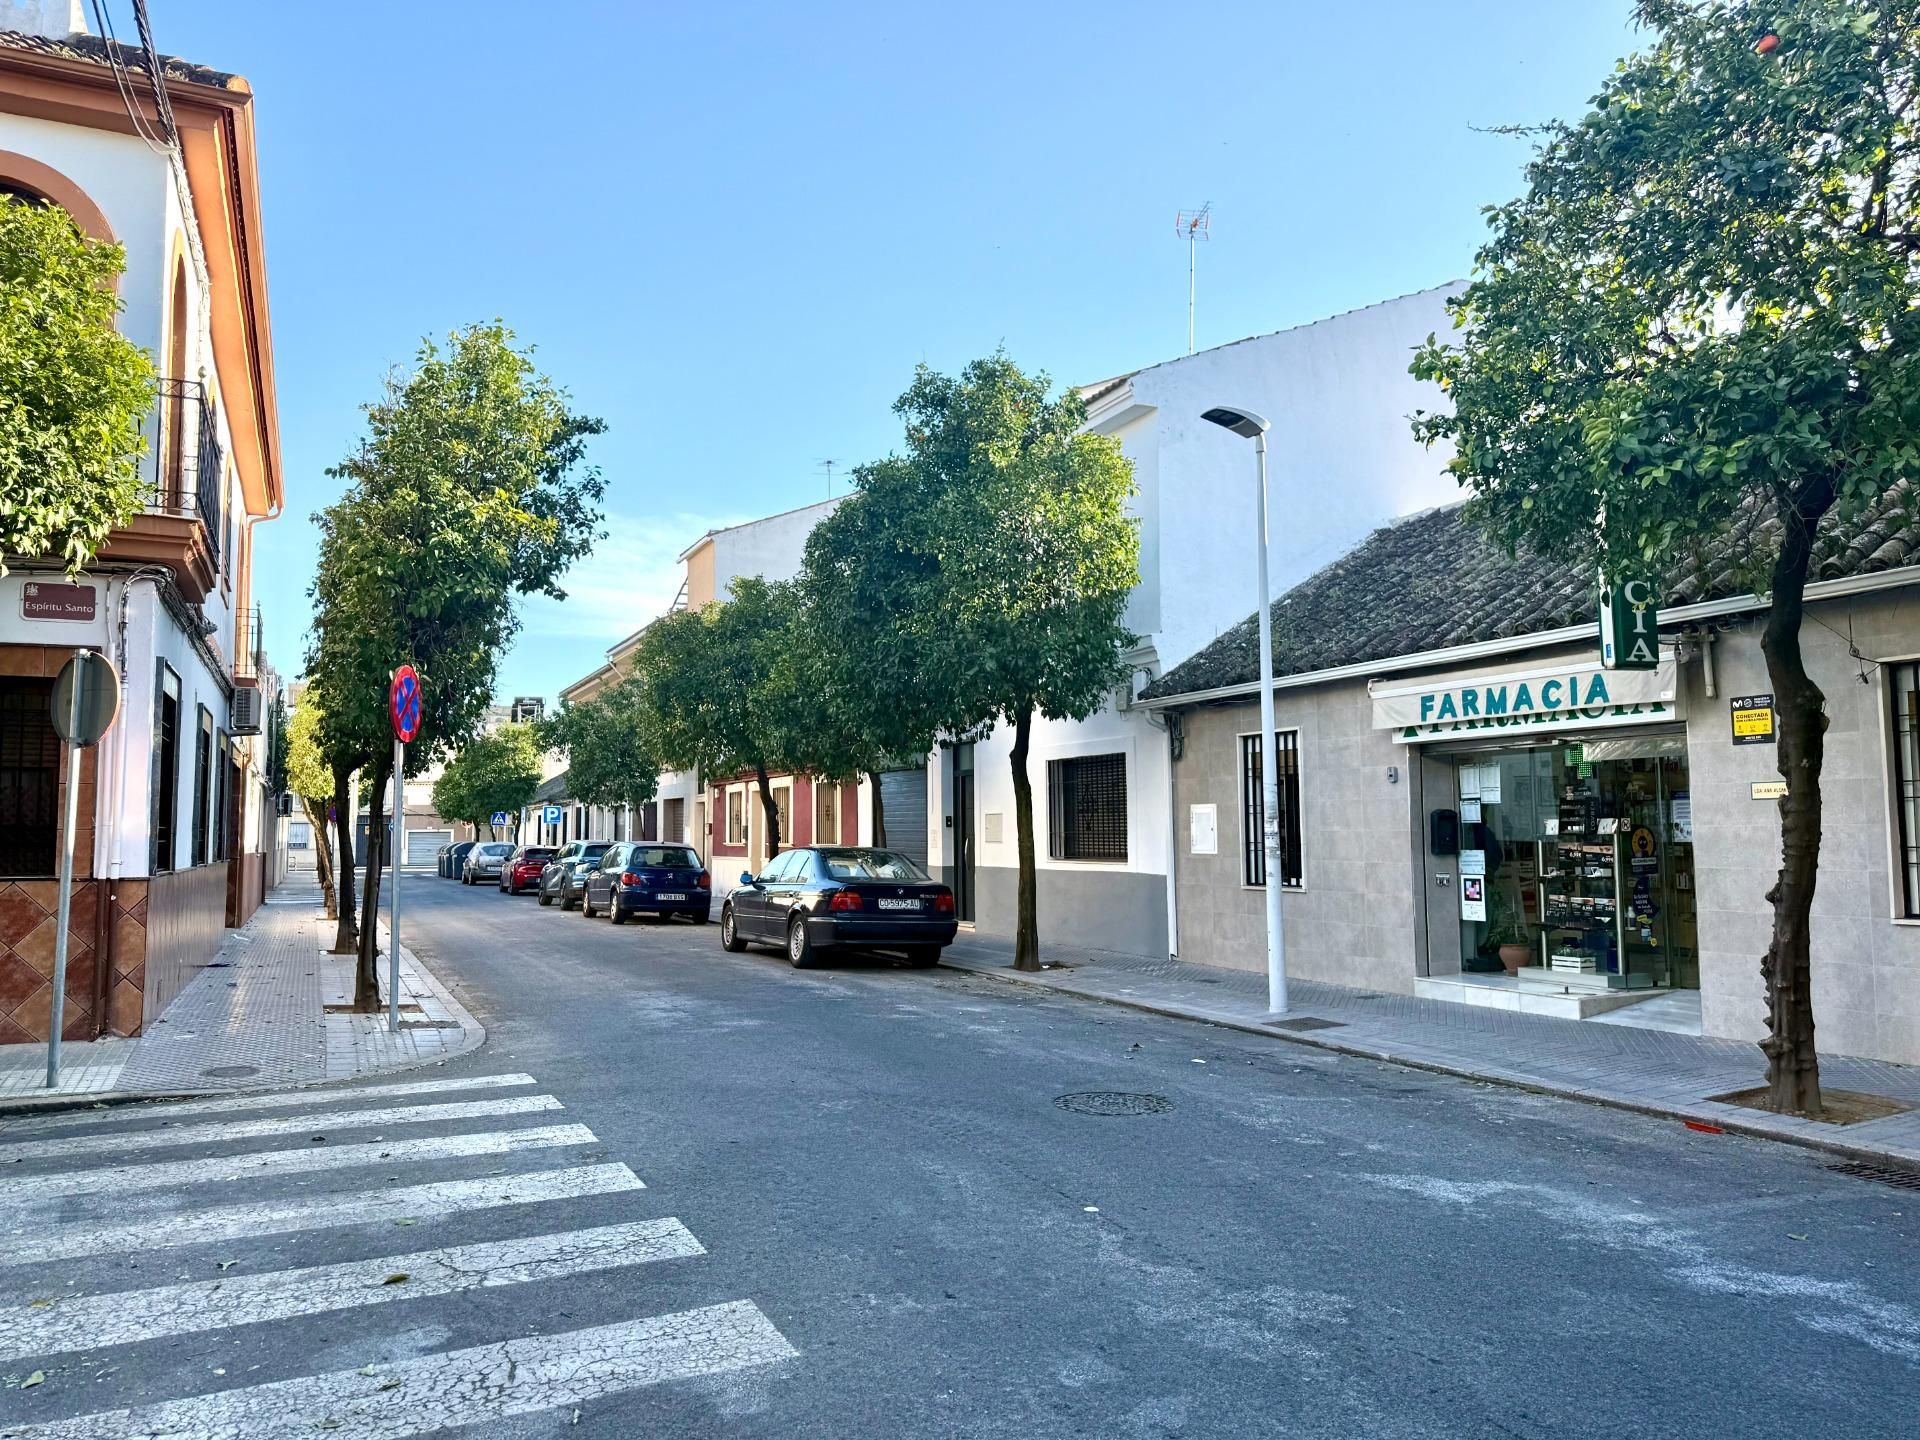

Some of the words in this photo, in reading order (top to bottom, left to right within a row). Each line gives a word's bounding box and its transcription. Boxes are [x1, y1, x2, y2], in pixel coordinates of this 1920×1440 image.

[25, 601, 62, 612] Espíritu
[65, 603, 94, 613] Santo
[1420, 673, 1611, 722] FARMACIA
[546, 808, 559, 822] P
